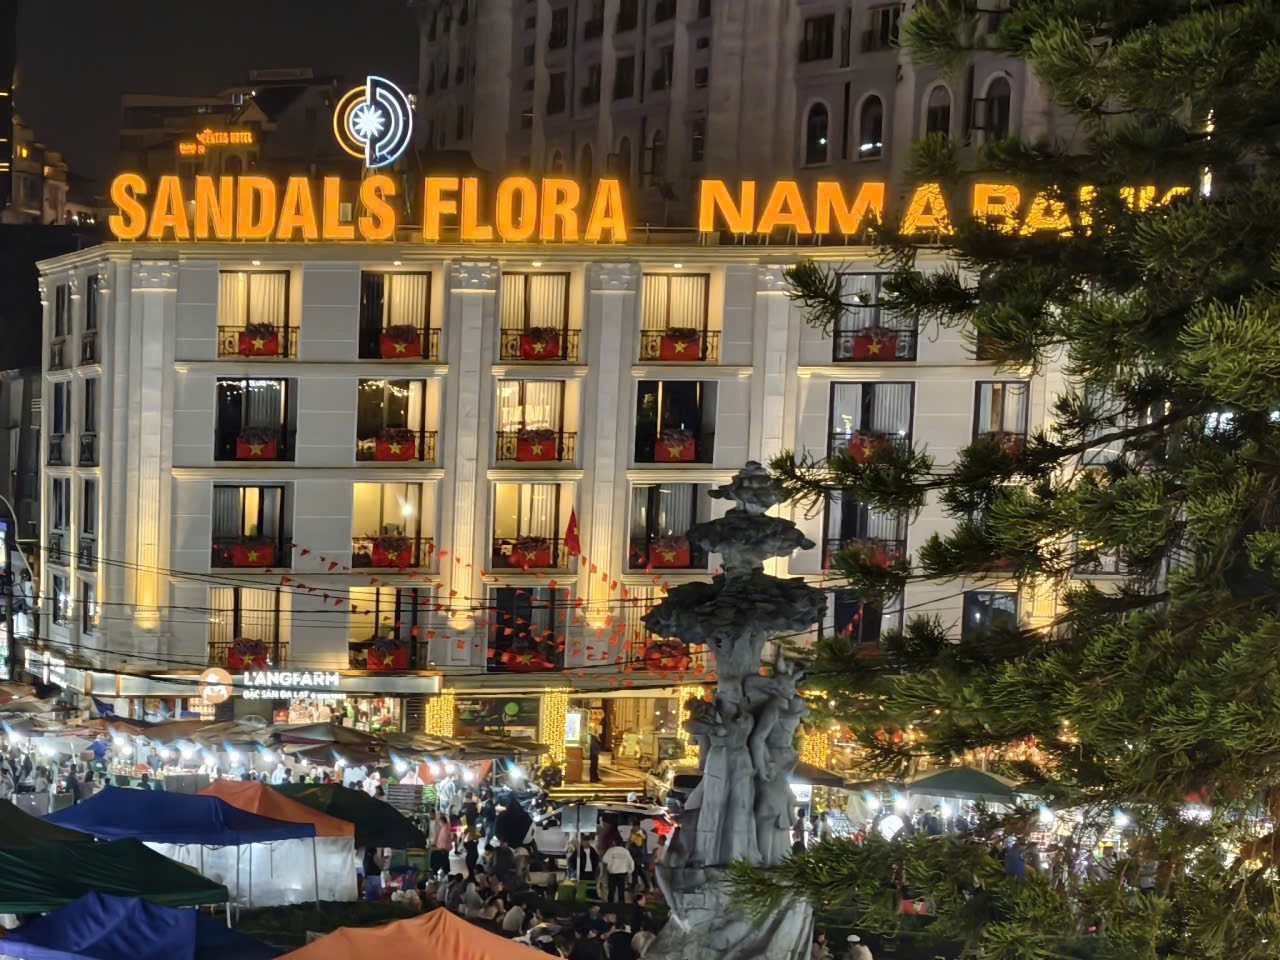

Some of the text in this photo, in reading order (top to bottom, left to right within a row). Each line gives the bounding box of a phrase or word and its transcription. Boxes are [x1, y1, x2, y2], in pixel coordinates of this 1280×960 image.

[108, 173, 628, 242] SANDALS FLORA
[700, 179, 886, 235] NAM
